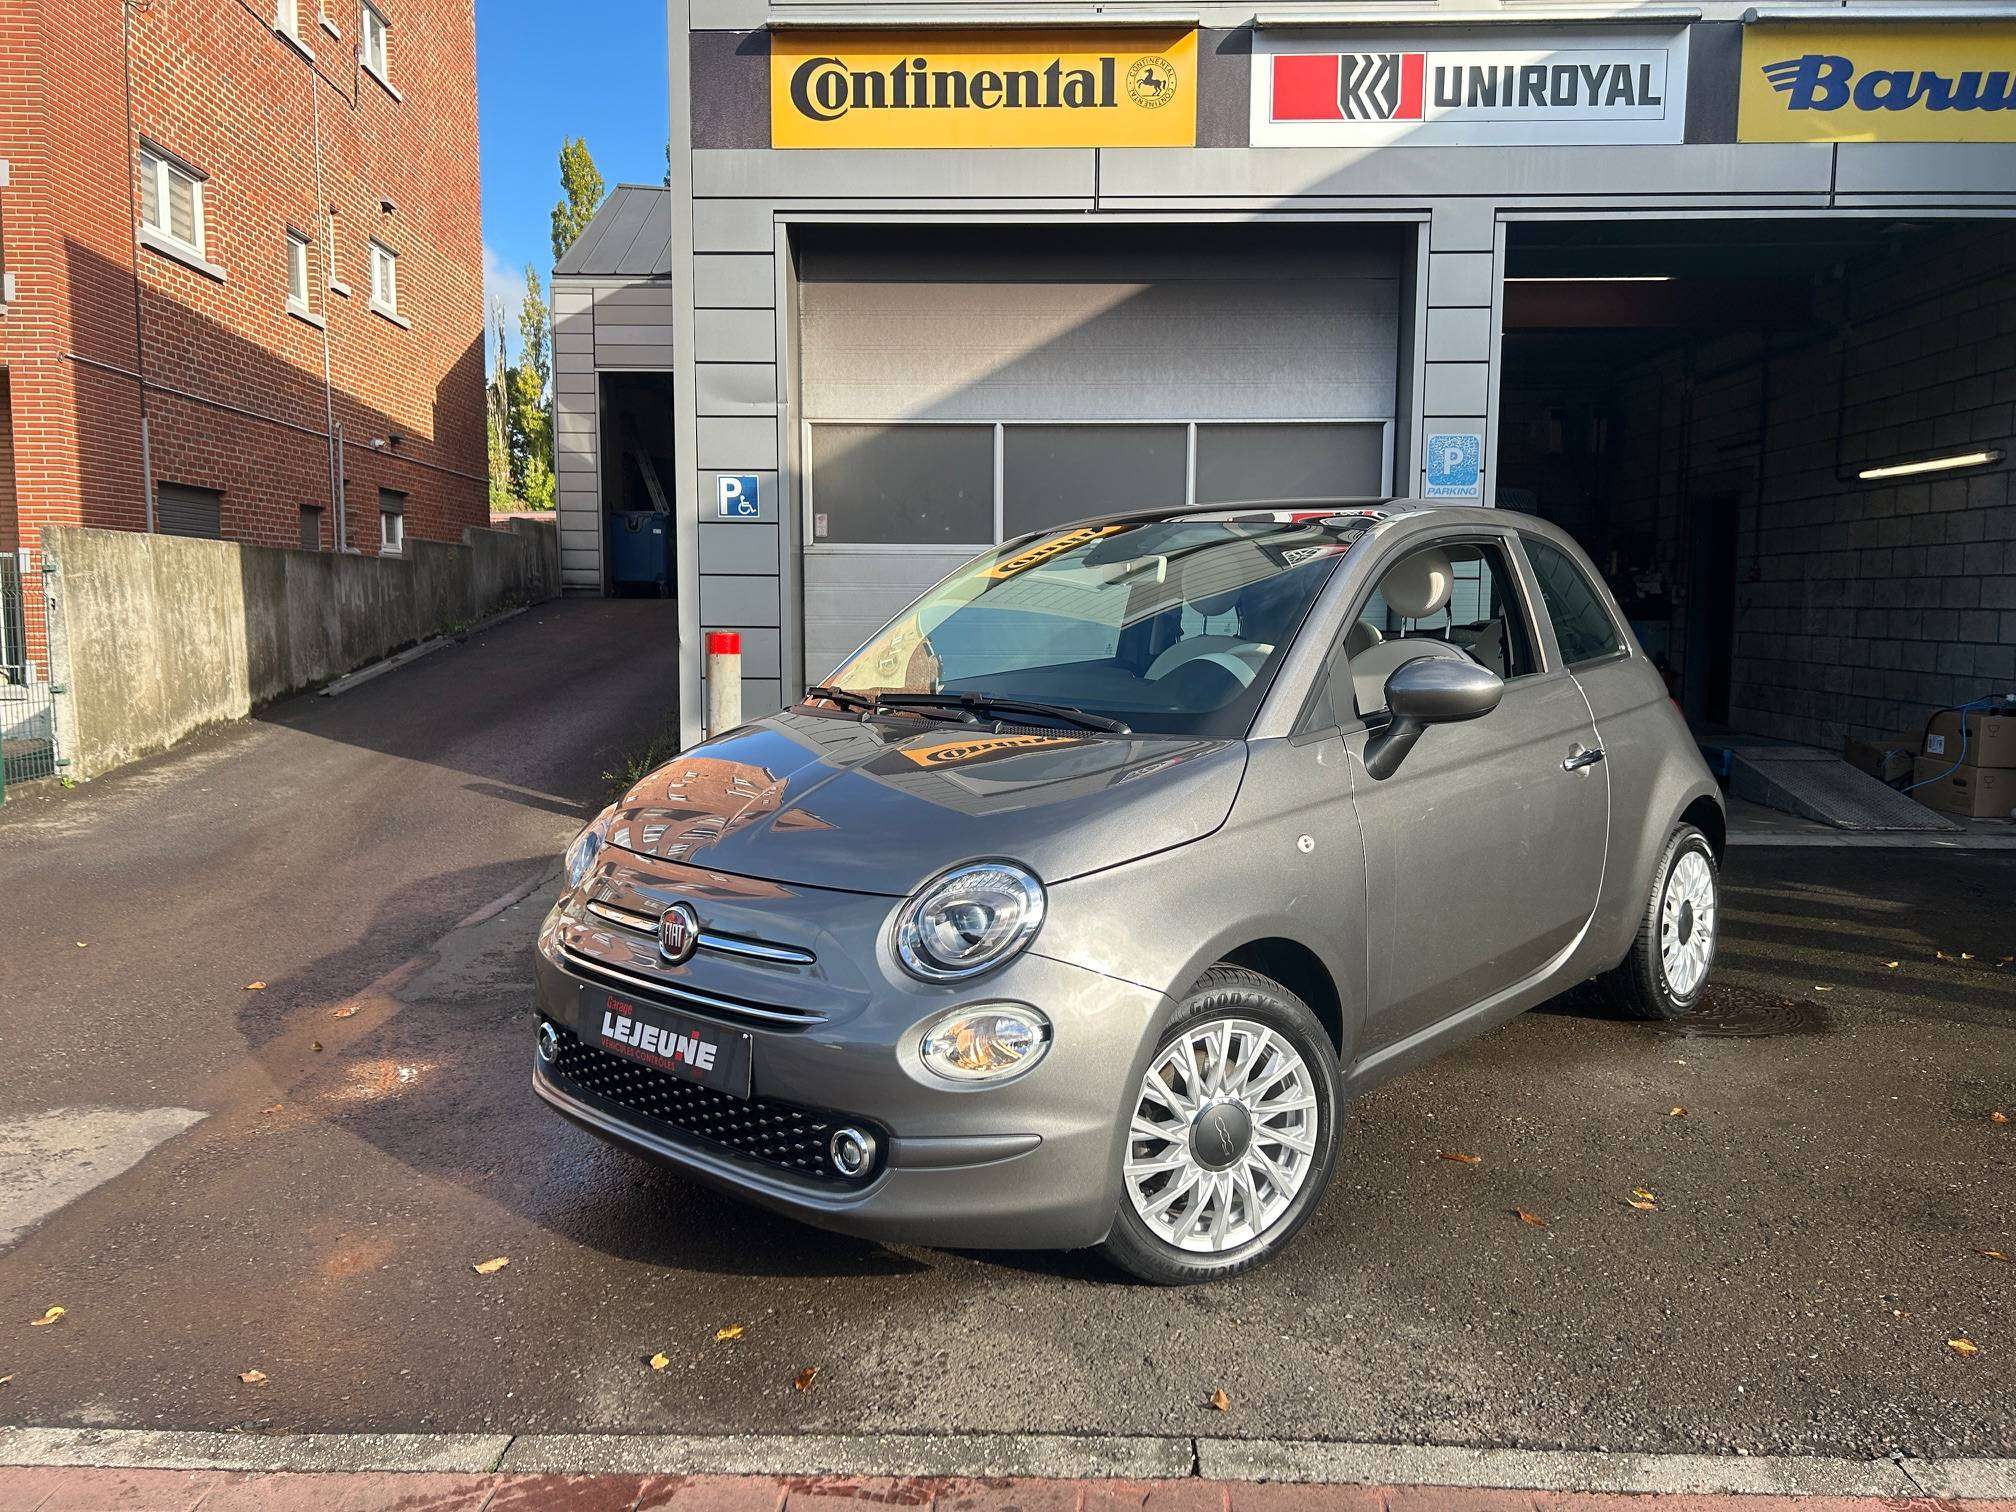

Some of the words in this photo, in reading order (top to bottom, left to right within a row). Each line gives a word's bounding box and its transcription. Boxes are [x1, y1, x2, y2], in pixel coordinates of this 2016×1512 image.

[1129, 57, 1174, 77] CONTINENTAL
[1762, 55, 2016, 111] Baru
[790, 57, 1118, 121] Continental
[1434, 64, 1661, 107] UNIROYAL
[1443, 447, 1464, 475] P
[719, 478, 742, 515] P
[1427, 487, 1477, 495] PARKING
[664, 921, 685, 947] FIAT
[607, 996, 632, 1015] Garage
[601, 1011, 718, 1071] LEJEUNE
